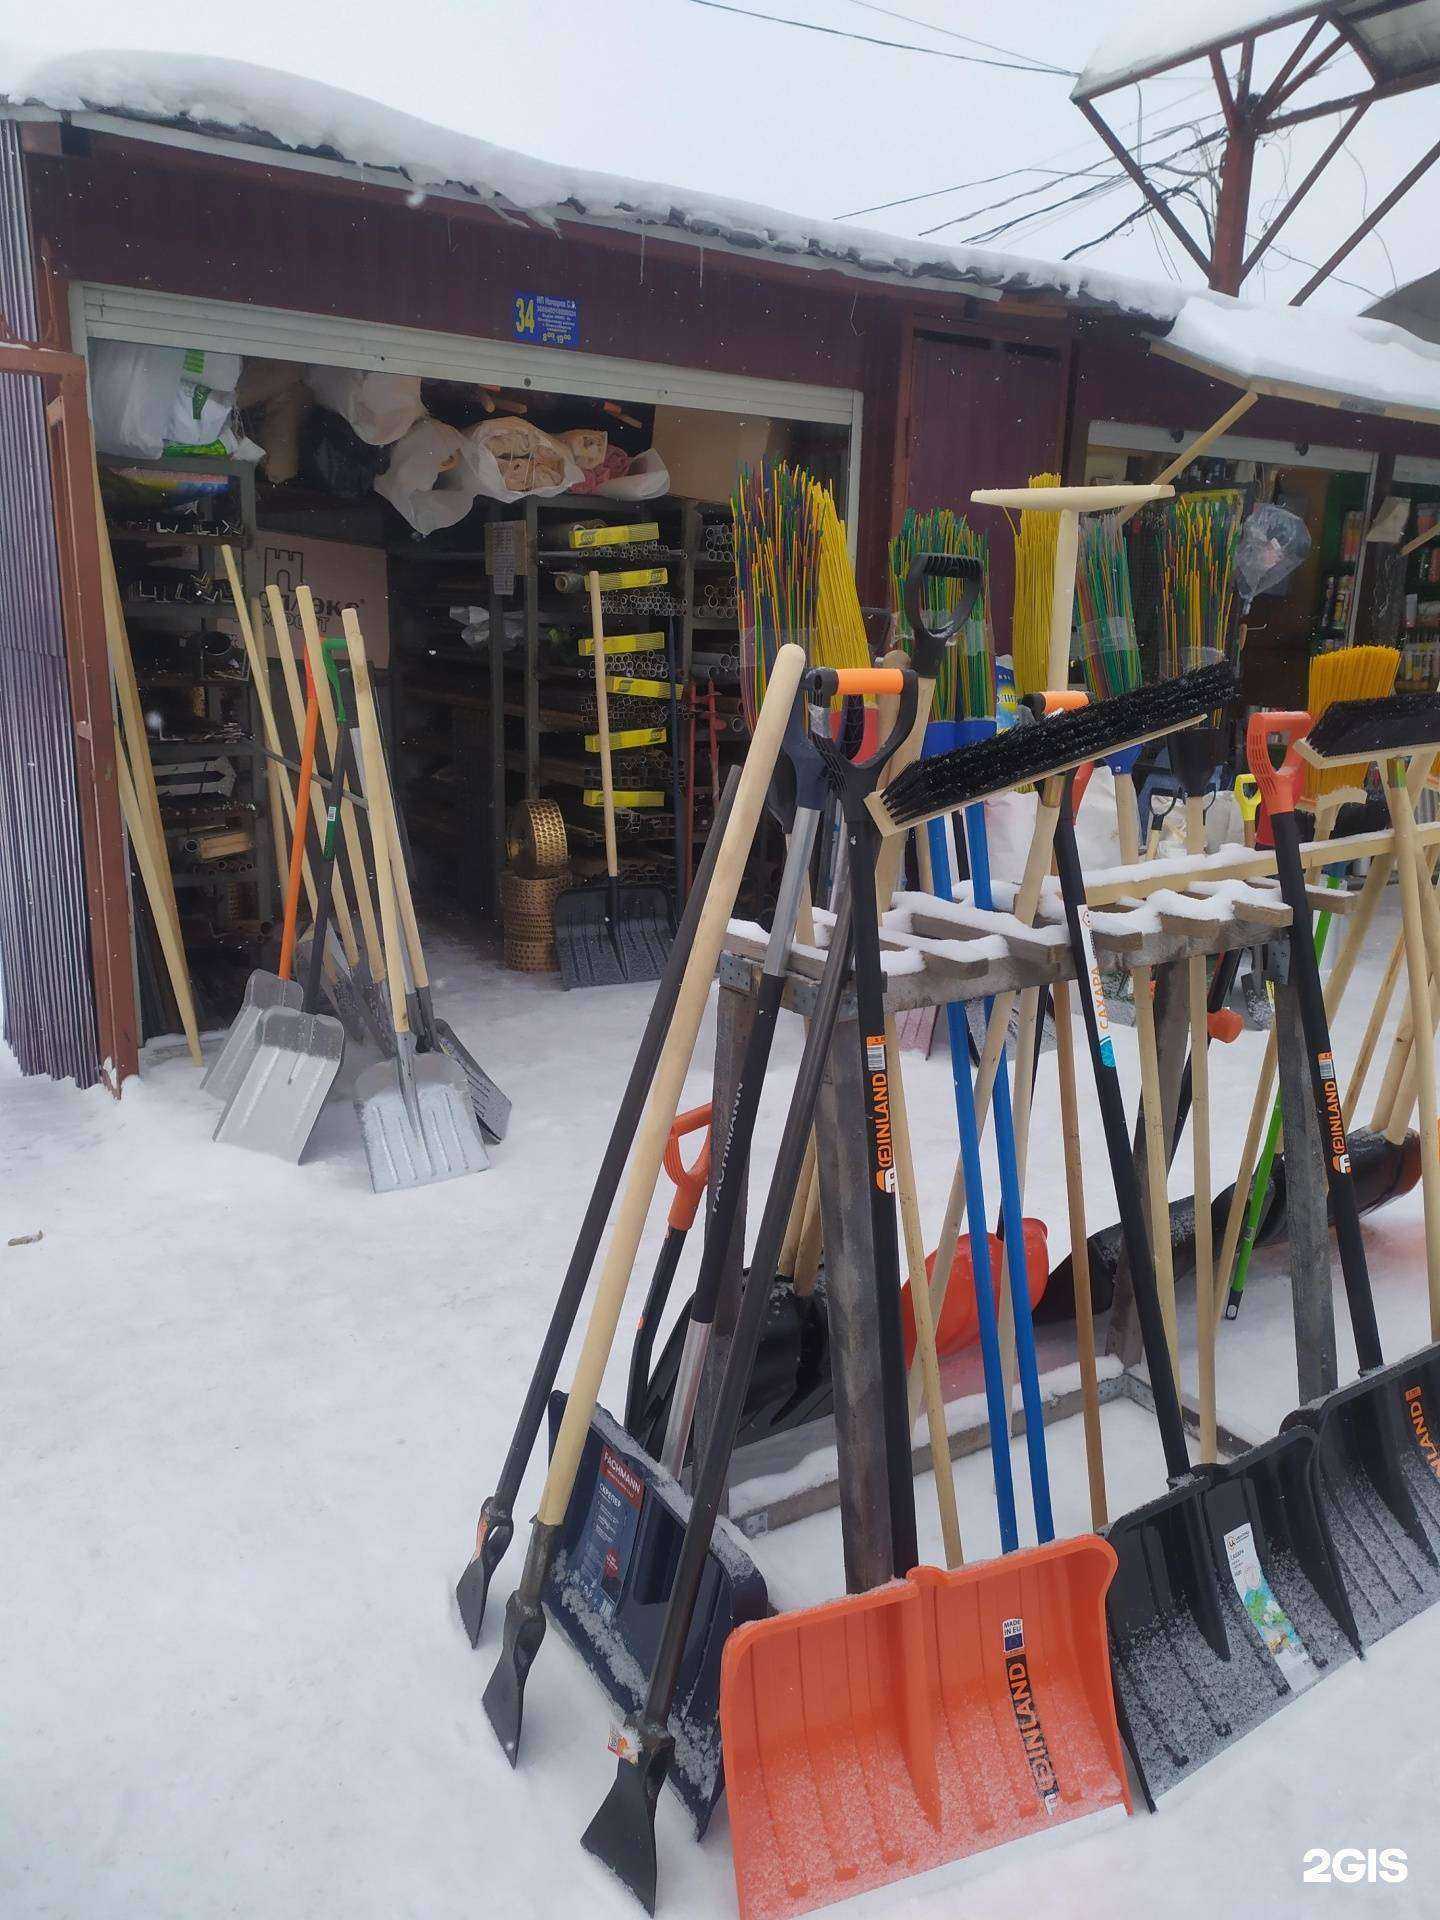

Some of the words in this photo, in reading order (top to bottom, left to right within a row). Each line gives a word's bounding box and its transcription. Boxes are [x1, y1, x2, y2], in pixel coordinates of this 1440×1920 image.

[515, 297, 535, 334] 34
[604, 1450, 641, 1495] FACHMANN
[1003, 1619, 1021, 1629] MADE
[1013, 1625, 1021, 1634] EU
